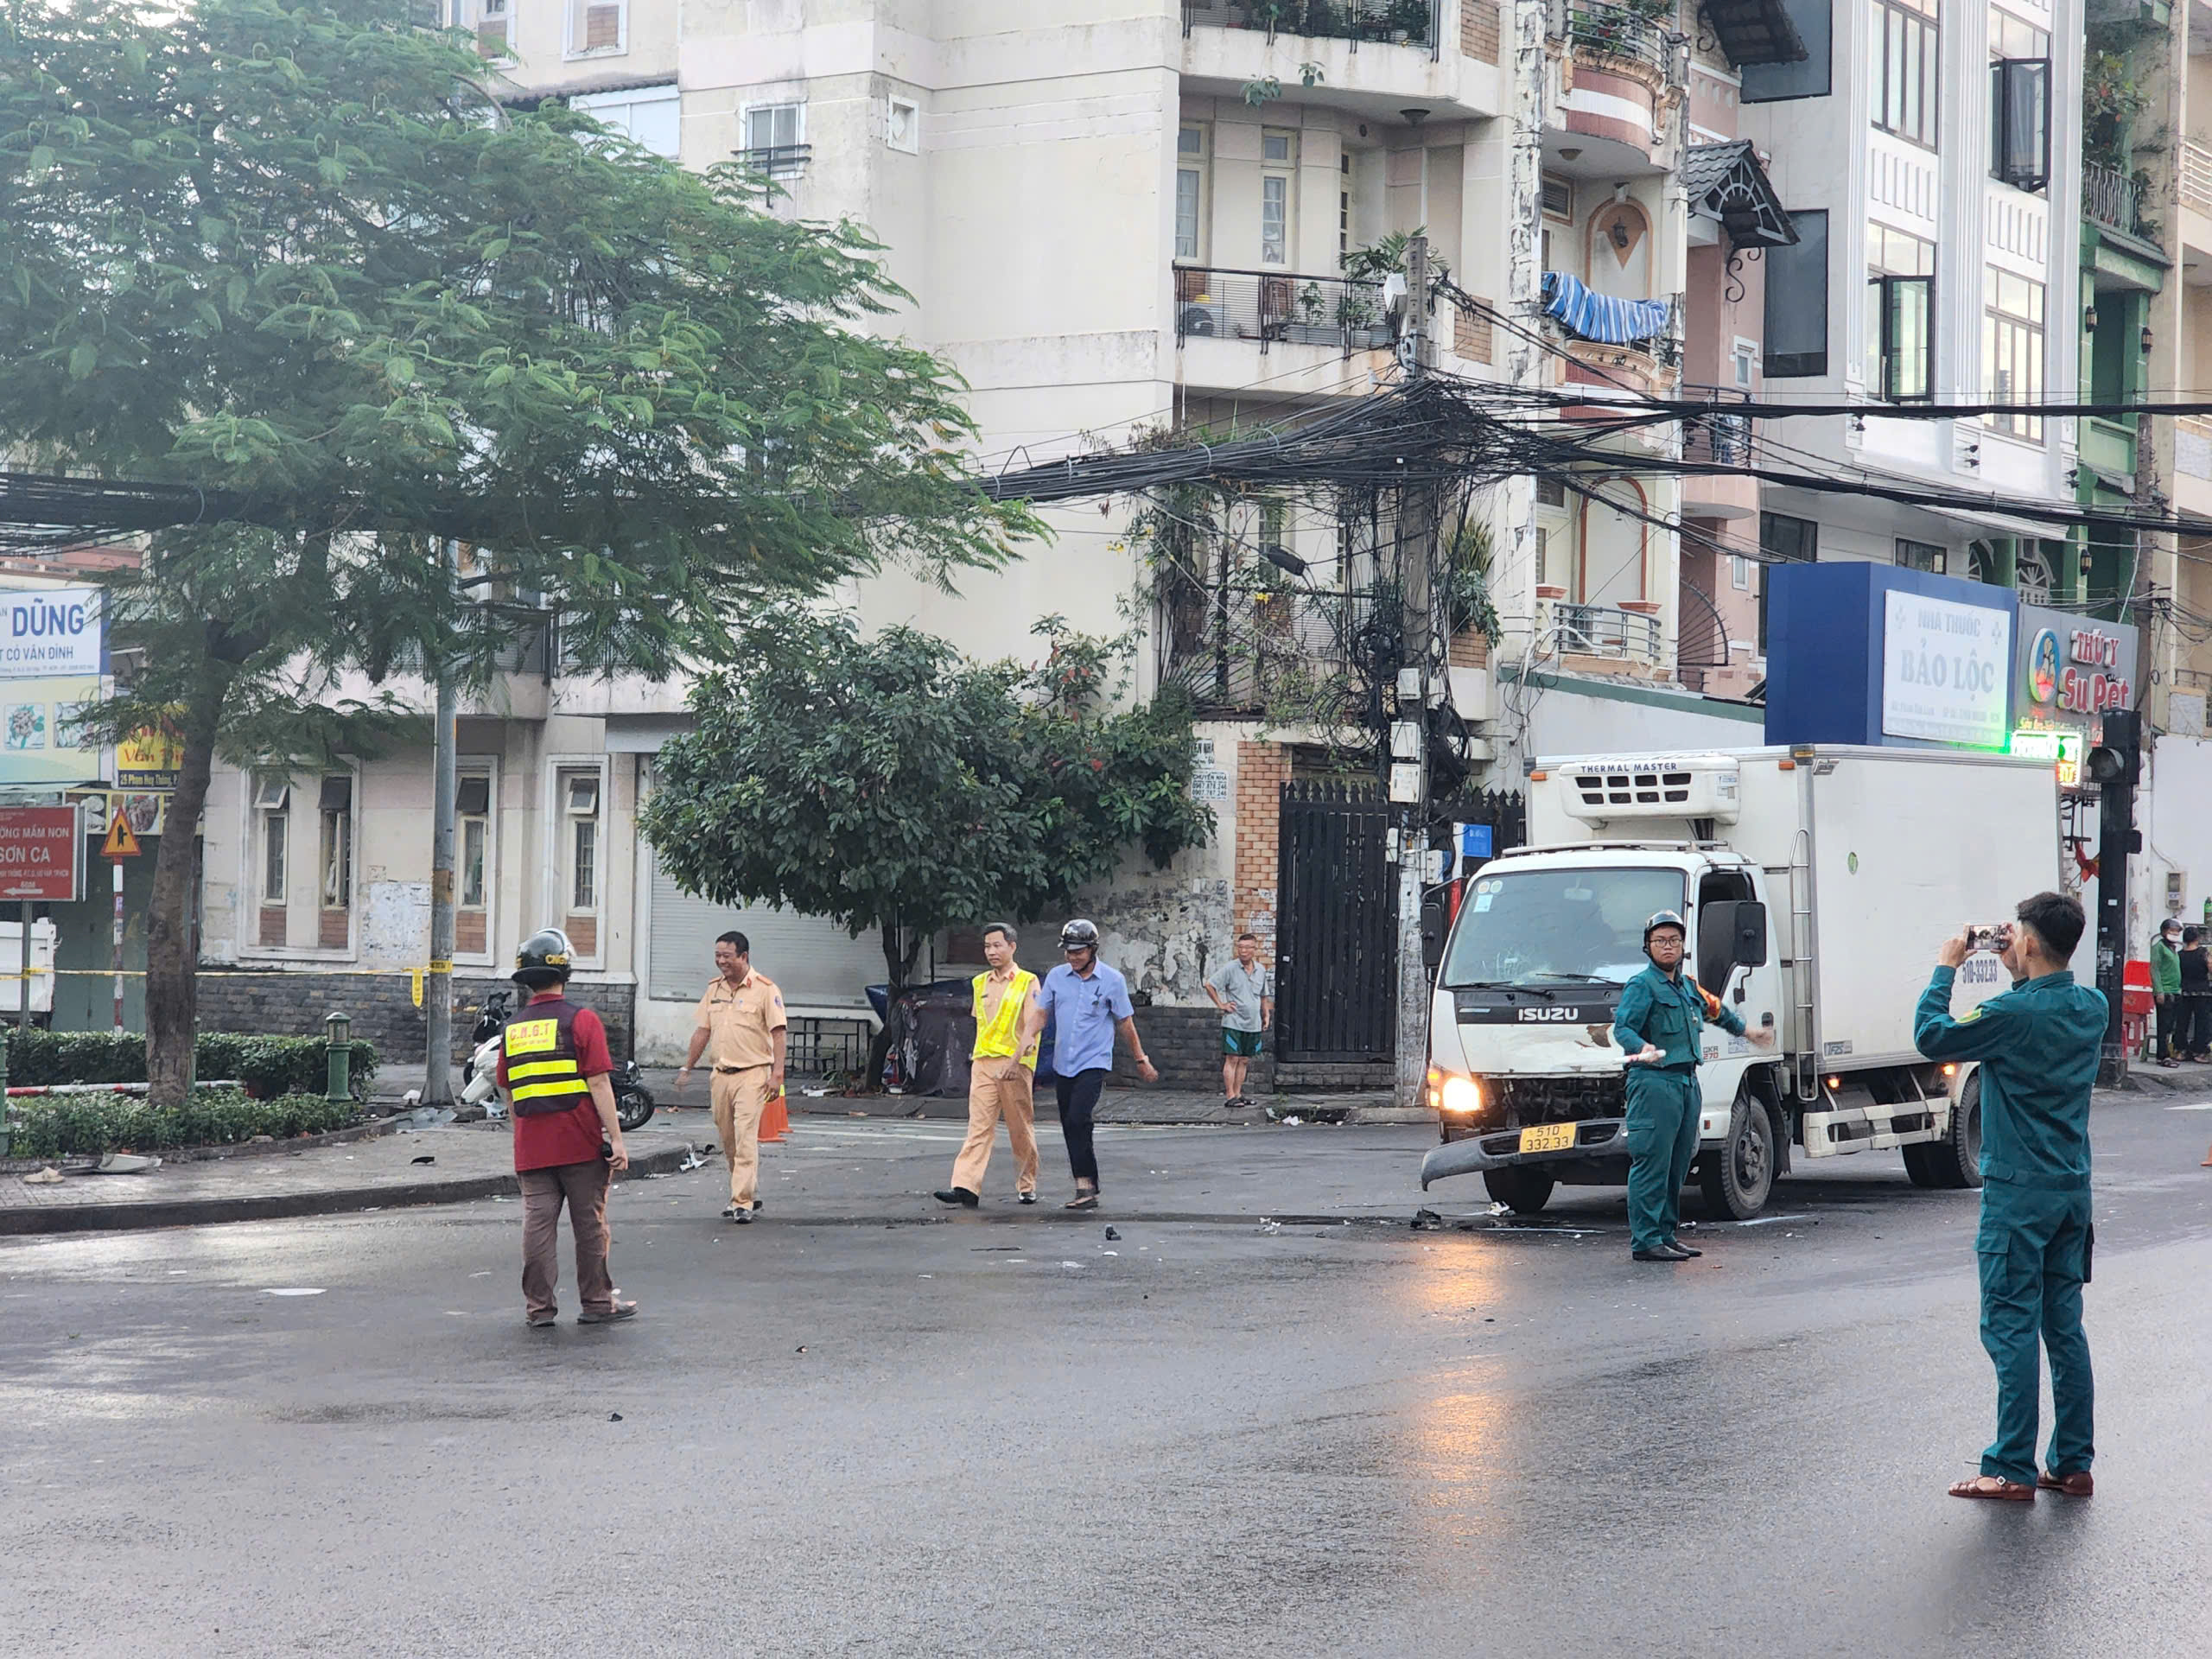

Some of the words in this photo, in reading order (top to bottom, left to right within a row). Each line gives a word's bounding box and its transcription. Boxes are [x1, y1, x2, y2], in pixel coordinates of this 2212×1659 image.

[12, 597, 84, 637] DŨNG
[1944, 608, 1981, 638] THUỐC
[22, 643, 45, 660] VÂN
[48, 643, 73, 659] ĐÌNH
[2071, 629, 2106, 665] THÚ
[2104, 638, 2120, 667] Y
[1900, 637, 1948, 688] BẢO
[1953, 648, 1995, 700] LỘC
[2058, 666, 2088, 713] Su
[2089, 673, 2129, 714] Pet
[1581, 763, 1630, 773] THERMAL
[1633, 762, 1678, 772] MASTER
[48, 828, 69, 837] NON
[0, 845, 26, 863] SƠN
[30, 847, 51, 863] CA
[1518, 1007, 1579, 1021] ISUZU
[1536, 1126, 1560, 1137] 51D
[1526, 1136, 1569, 1151] 332.33
